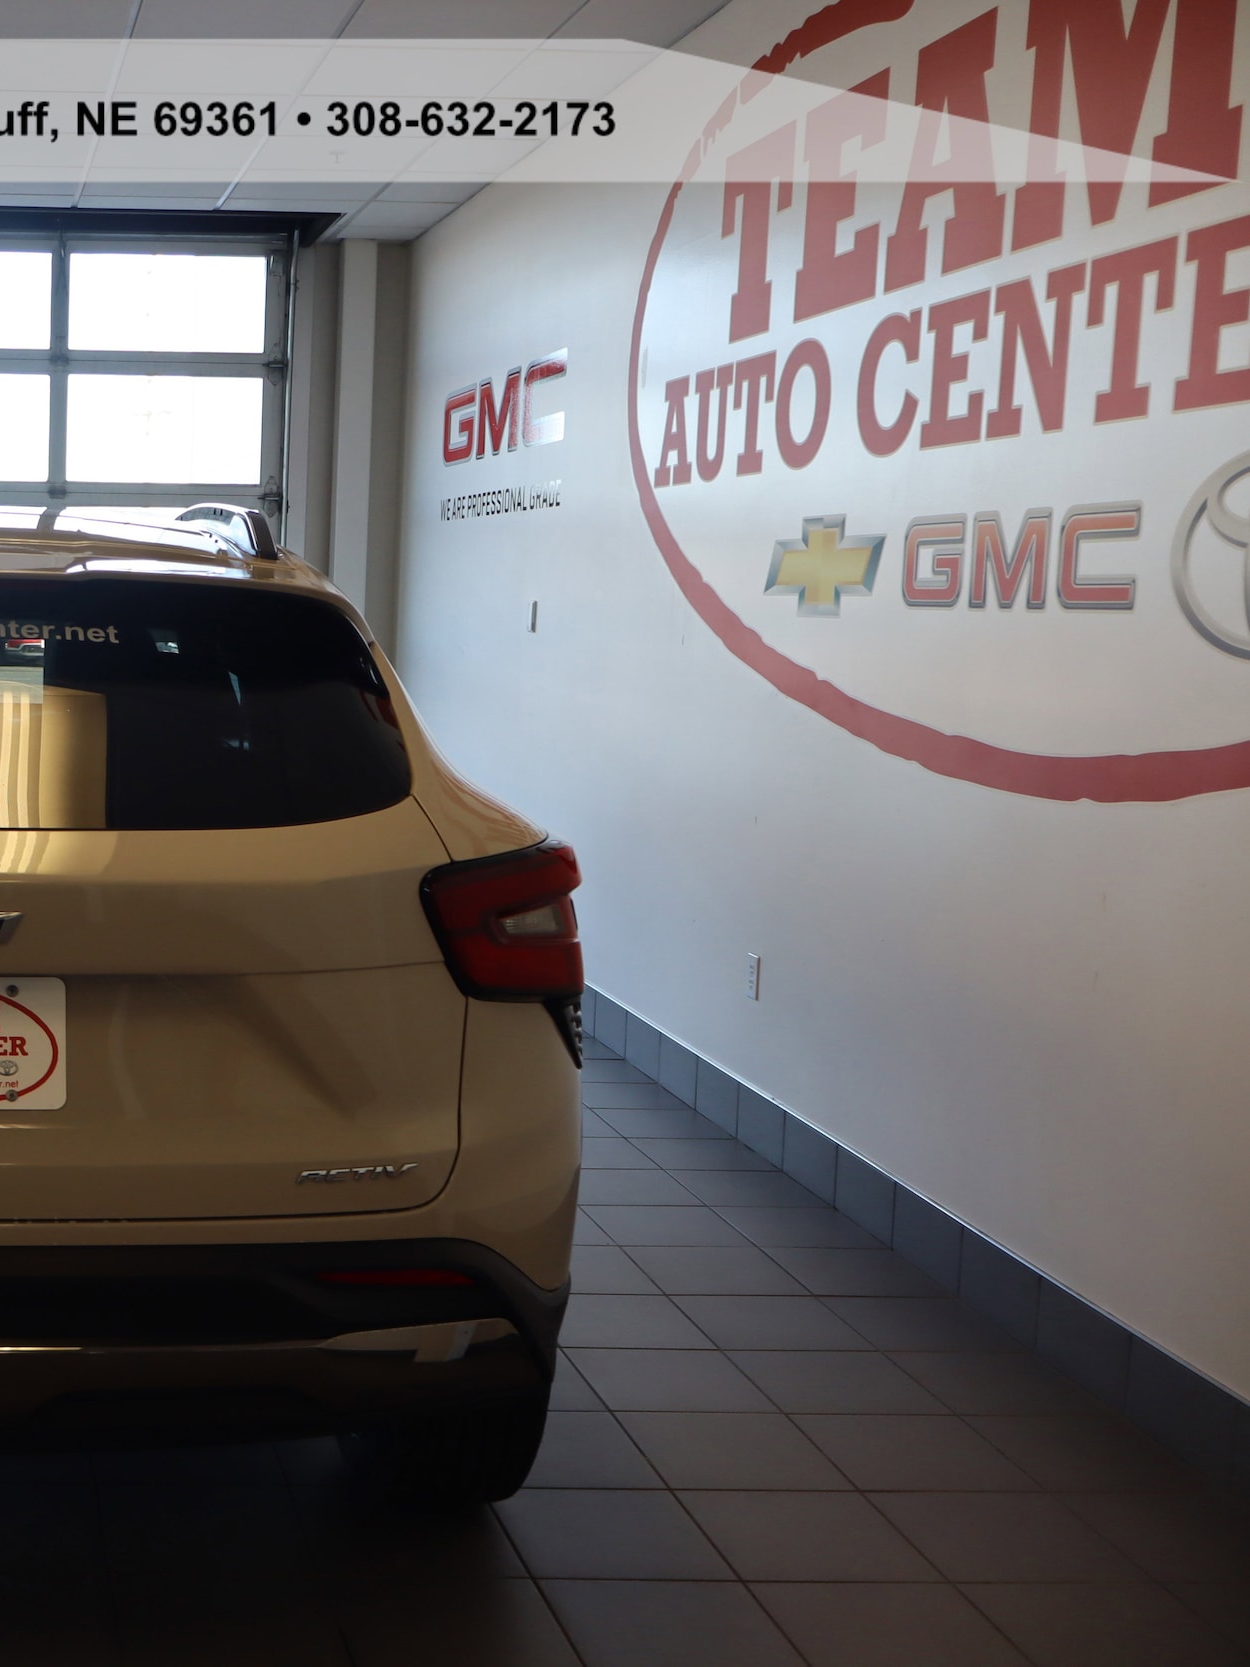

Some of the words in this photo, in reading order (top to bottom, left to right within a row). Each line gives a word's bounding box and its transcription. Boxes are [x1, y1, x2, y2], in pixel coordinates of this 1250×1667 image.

[721, 0, 1244, 344] TEAM
[443, 346, 569, 467] GMC
[653, 337, 832, 488] AUTO
[440, 498, 451, 522] WE
[452, 496, 466, 520] ARE
[467, 486, 527, 518] PROFESSIONAL
[902, 500, 1144, 613] GMC
[295, 1162, 419, 1185] ACTIV
